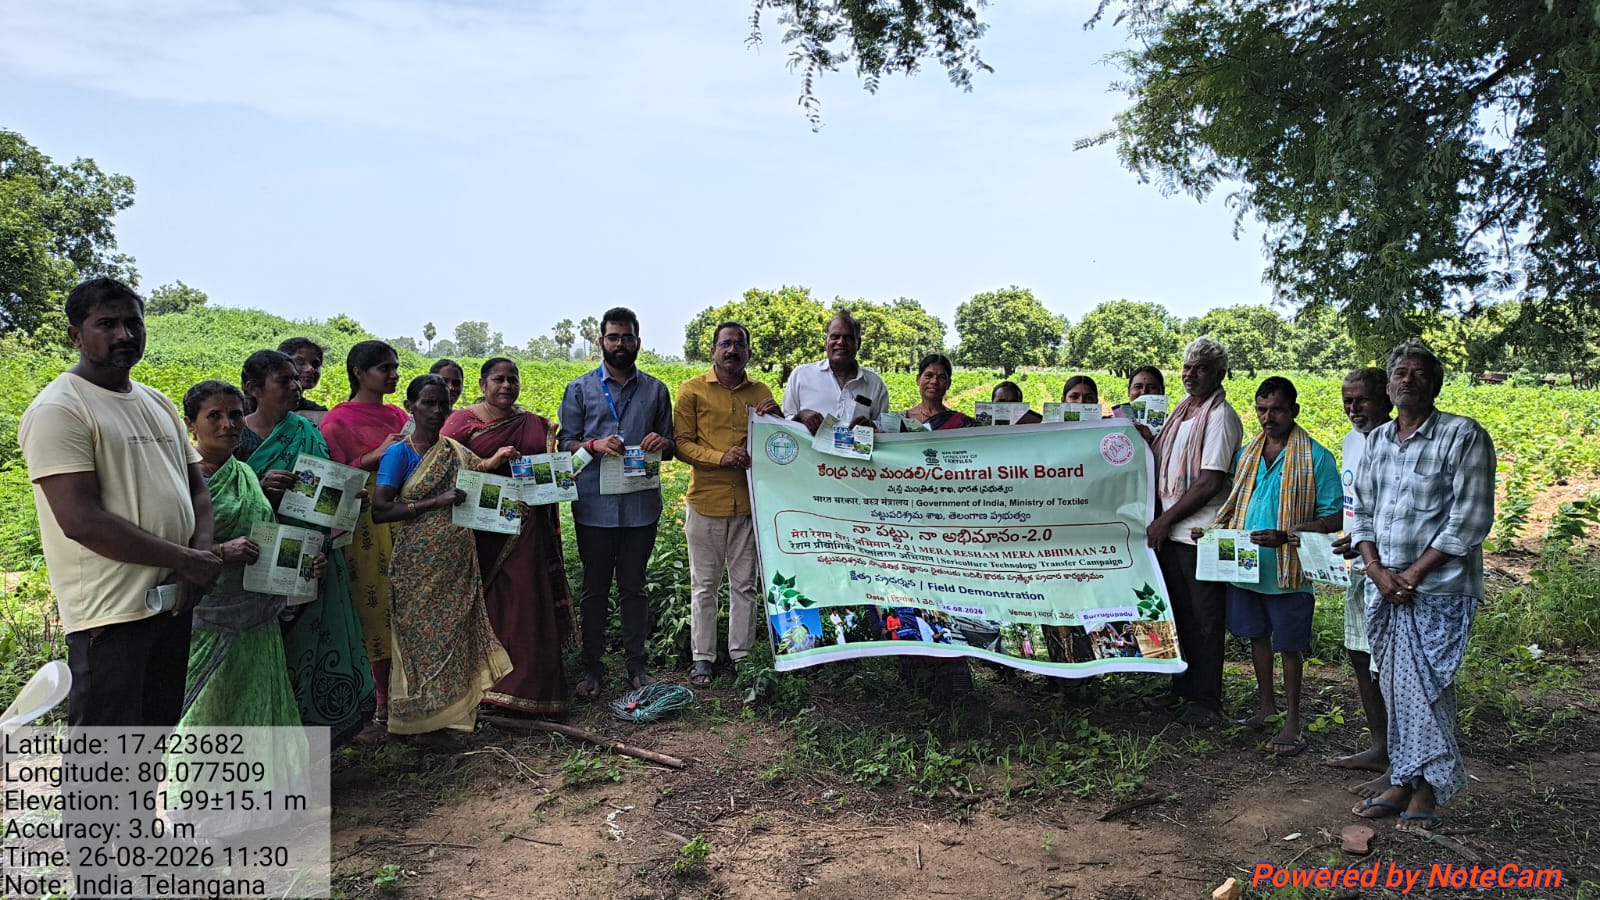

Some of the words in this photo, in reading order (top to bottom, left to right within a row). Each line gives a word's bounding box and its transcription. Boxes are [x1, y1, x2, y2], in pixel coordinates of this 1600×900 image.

[817, 463, 848, 480] కేంద్ర
[851, 466, 877, 480] పట్టు
[998, 465, 1029, 480] Silk
[1034, 464, 1084, 479] Board
[958, 485, 978, 493] భారత
[980, 485, 1013, 494] ప్రభుత్వం
[813, 495, 832, 504] भारत
[863, 498, 879, 506] वस्त्र
[881, 497, 909, 507] मंत्रालय
[916, 499, 970, 508] Government
[972, 499, 981, 507] of
[983, 499, 1007, 508] India,
[1009, 498, 1044, 508] Ministry
[1046, 498, 1056, 506] of
[1057, 497, 1089, 506] Textiles
[949, 511, 988, 520] తెలంగాణ
[990, 511, 1031, 523] ప్రభుత్వం
[853, 525, 871, 534] నా
[876, 524, 913, 543] పట్టు,
[919, 531, 937, 541] నా
[791, 529, 808, 538] मेरा
[809, 528, 832, 539] रेशम
[834, 532, 850, 542] मेरा
[853, 537, 891, 548] अभिमान
[919, 546, 951, 556] MERA
[953, 550, 999, 559] RESHAM
[1002, 550, 1035, 559] MERA
[1037, 547, 1097, 558] ABHIMAAN
[788, 540, 811, 550] रेशम
[899, 551, 934, 562] अभियान
[940, 559, 987, 568] Sericulture
[988, 561, 1037, 570] Technology
[1040, 560, 1076, 568] Transfer
[1079, 558, 1123, 567] Campaign
[928, 582, 955, 593] Field
[958, 585, 1045, 600] Demonstration
[866, 593, 885, 602] Date
[1008, 608, 1032, 617] Venue
